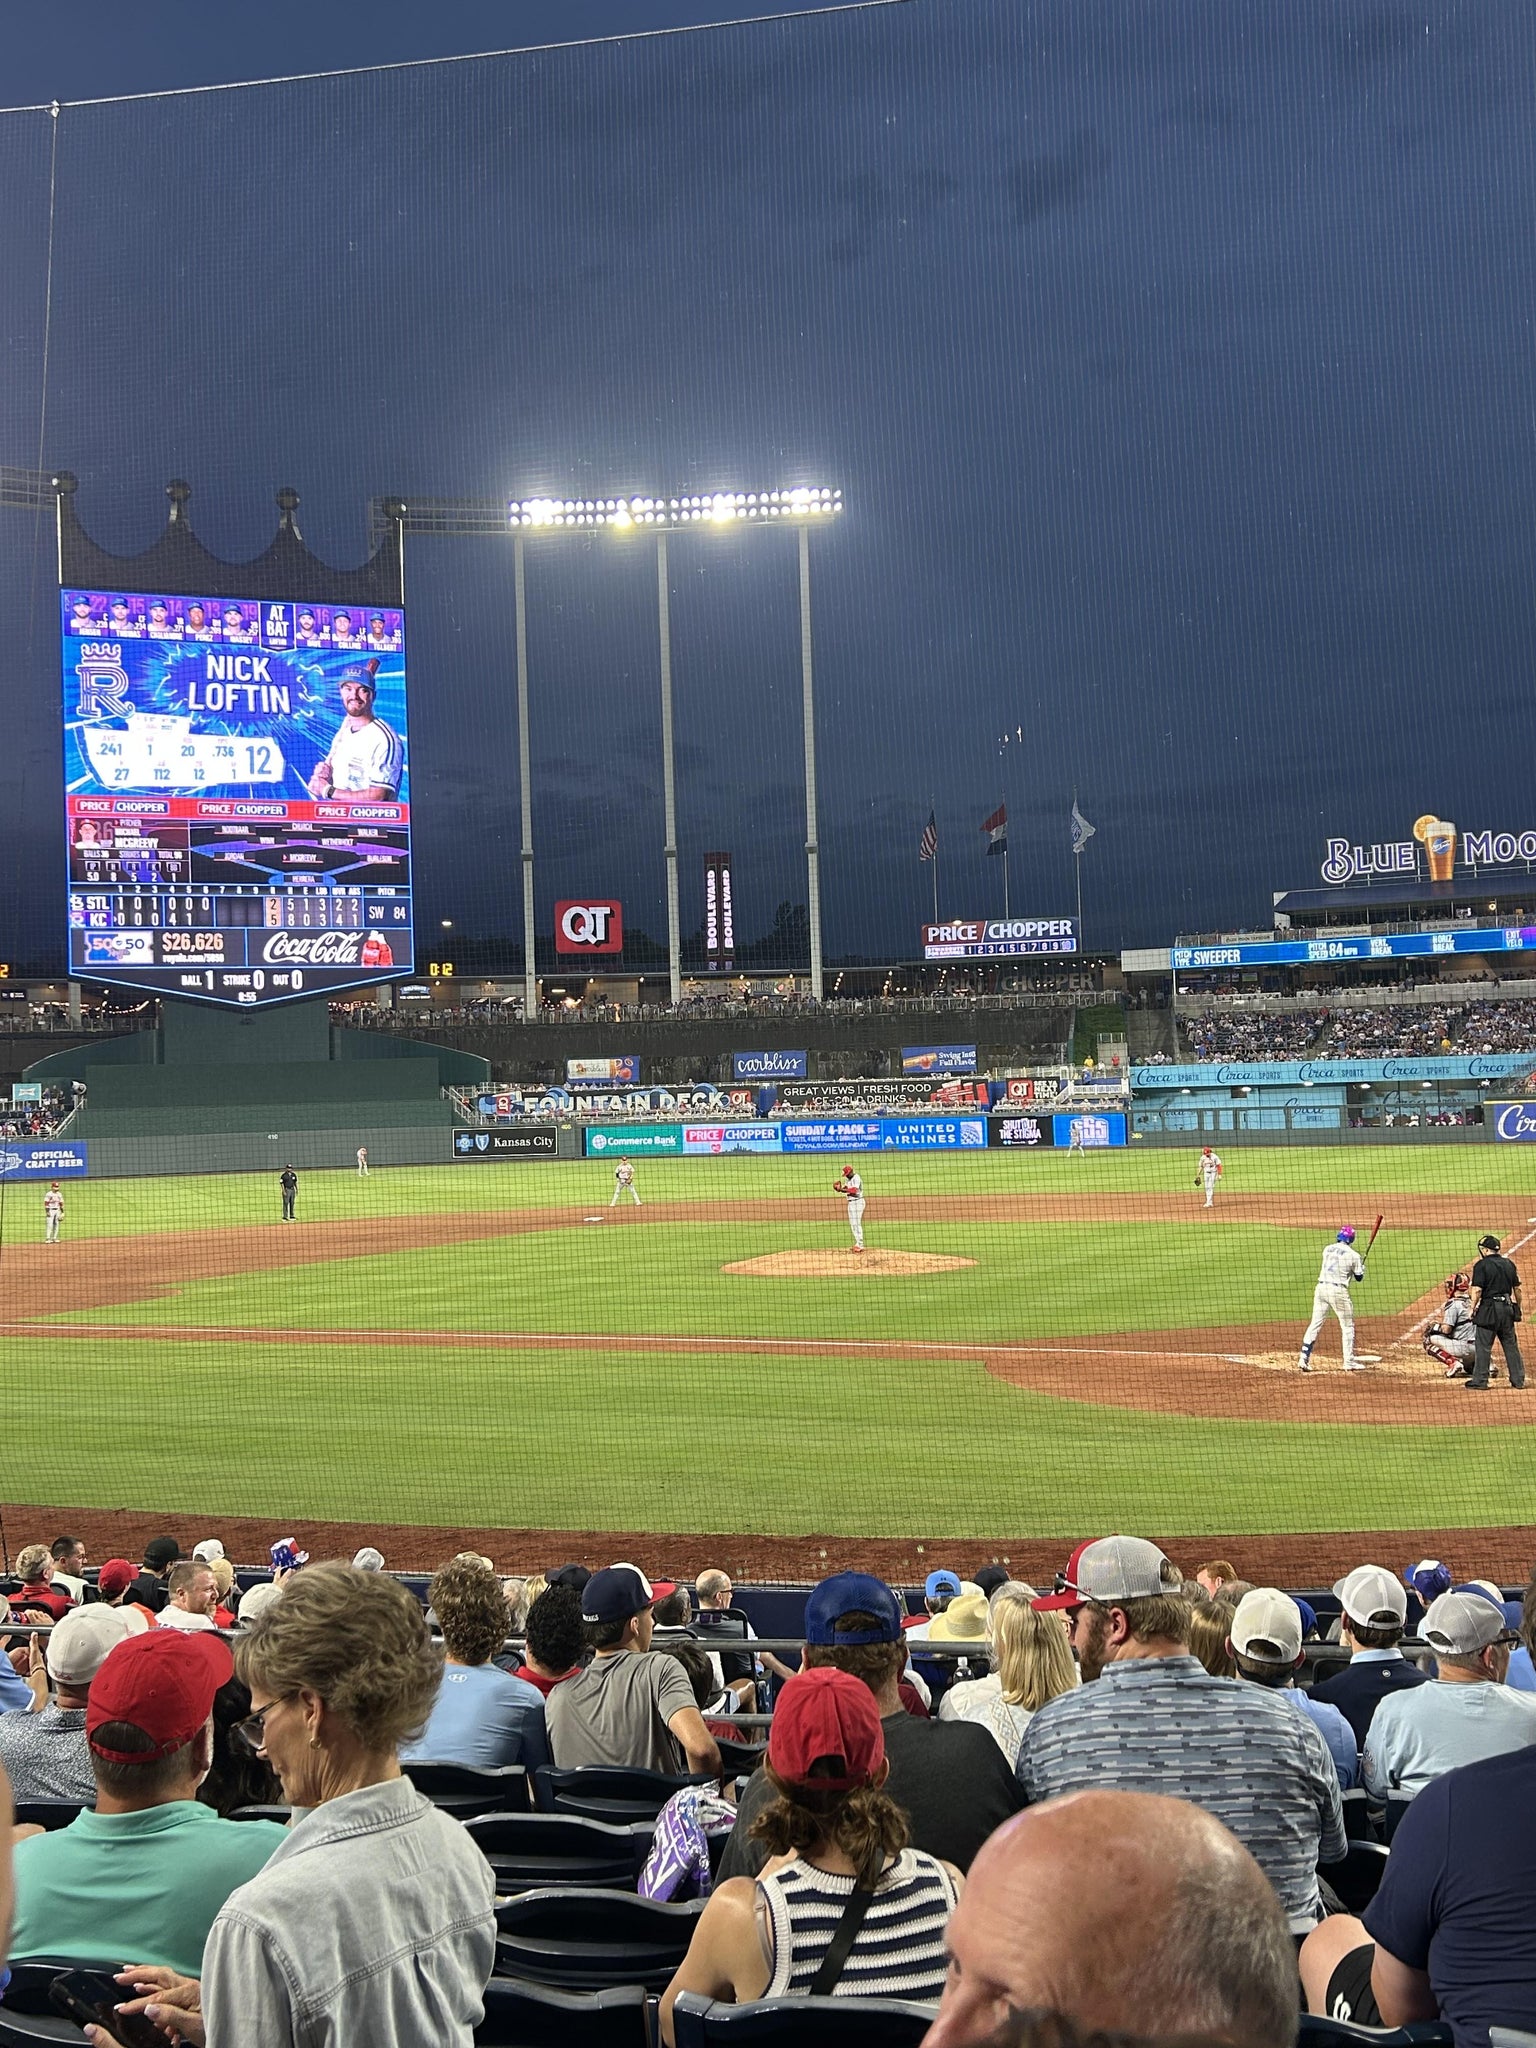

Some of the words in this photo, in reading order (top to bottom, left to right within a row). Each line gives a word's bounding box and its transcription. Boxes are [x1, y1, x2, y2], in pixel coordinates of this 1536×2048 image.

[130, 599, 144, 614] 15
[169, 601, 182, 616] 14
[244, 605, 256, 620] 19
[270, 605, 285, 620] AT
[266, 621, 289, 636] BAT
[207, 654, 273, 682] NICK
[188, 682, 291, 714] LOFTIN
[96, 744, 122, 756] .241
[181, 746, 195, 757] 20
[212, 746, 234, 757] .736
[245, 747, 272, 774] 12
[114, 769, 129, 781] 27
[154, 769, 170, 780] 112
[194, 769, 205, 780] 12
[80, 801, 110, 811] PRICE
[117, 802, 164, 812] CHOPPER
[202, 804, 230, 814] PRICE
[236, 805, 283, 815] CHOPPER
[319, 807, 346, 816] PRICE
[352, 808, 397, 818] CHOPPER
[1321, 838, 1416, 884] BLUE
[87, 873, 99, 881] 5.0
[131, 873, 137, 881] 5
[152, 873, 157, 881] 2
[135, 885, 141, 893] 2
[152, 885, 158, 893] 3
[186, 886, 192, 894] 5
[86, 896, 110, 910] STL
[118, 897, 124, 910] 1
[134, 897, 142, 910] 0
[152, 897, 157, 910] 1
[169, 897, 176, 910] 0
[186, 897, 193, 911] 0
[202, 897, 209, 911] 0
[271, 899, 276, 910] 2
[287, 899, 294, 911] 5
[319, 899, 326, 911] 3
[336, 899, 342, 911] 2
[352, 899, 358, 911] 2
[707, 870, 717, 949] BOULEVARD
[723, 870, 734, 948] BOULEVARD
[369, 906, 384, 919] SW
[393, 906, 405, 919] 84
[90, 913, 107, 927] KC
[118, 913, 125, 925] 0
[135, 913, 142, 926] 0
[151, 913, 159, 926] 0
[169, 913, 176, 926] 4
[271, 914, 277, 925] 5
[288, 915, 295, 926] 8
[304, 915, 310, 926] 0
[320, 915, 326, 926] 3
[336, 915, 343, 926] 4
[562, 906, 612, 945] QT
[927, 925, 978, 942] PRICE
[988, 920, 1072, 939] CHOPPER
[126, 939, 145, 949] 50
[162, 932, 224, 951] $26,626
[263, 931, 364, 963] Coca-Cola
[988, 945, 994, 953] 3
[1010, 944, 1015, 952] 5
[1020, 944, 1026, 952] 6
[1053, 942, 1058, 950] 9
[1194, 949, 1241, 965] SWEEPER
[1308, 942, 1327, 951] PITCH
[1329, 942, 1343, 957] 84
[1370, 939, 1388, 947] VERT.
[1506, 930, 1520, 939] EXIT
[1175, 958, 1190, 966] TYPE
[1309, 950, 1328, 959] SPEED
[1371, 946, 1393, 956] BREAK
[1433, 943, 1455, 952] BREAK
[1506, 939, 1523, 947] VELO
[430, 963, 453, 976] 0:12
[181, 975, 202, 986] BALL
[205, 970, 213, 990] 1
[223, 975, 251, 986] STRIKE
[253, 969, 264, 990] 0
[273, 974, 289, 986] OUT
[292, 969, 303, 990] 0
[738, 1052, 802, 1072] carbliss
[939, 1052, 961, 1060] Swing
[1137, 1068, 1172, 1086] Circa
[1178, 1074, 1199, 1082] SPORTS
[1217, 1065, 1251, 1084] Circa
[1259, 1071, 1281, 1080] SPORTS
[1299, 1063, 1334, 1082] Circa
[1341, 1069, 1364, 1077] SPORTS
[1382, 1060, 1420, 1079] Circa
[1426, 1066, 1450, 1075] SPORTS
[1468, 1057, 1506, 1076] Circa
[783, 1087, 819, 1096] GREAT
[822, 1085, 855, 1095] VIEWS
[863, 1084, 899, 1094] FRESH
[901, 1083, 931, 1093] FOOD
[1010, 1083, 1029, 1097] QT
[1034, 1085, 1058, 1093] NEXT
[524, 1095, 651, 1113] FOUNTAIN
[659, 1091, 724, 1109] DECK
[731, 1093, 748, 1105] QT
[867, 1094, 907, 1104] DRINKS
[786, 1125, 826, 1136] SUNDAY
[828, 1124, 865, 1135] 4-PACK
[898, 1124, 956, 1133] UNITED
[1003, 1118, 1037, 1129] SHUTOUT
[607, 1137, 652, 1146] Commerce
[654, 1136, 676, 1145] Bank
[689, 1130, 719, 1141] PRICE
[725, 1128, 776, 1139] CHOPPER
[885, 1134, 956, 1145] AIRLINES
[999, 1129, 1017, 1139] THE
[1014, 1129, 1041, 1139] STIGMA
[494, 1138, 531, 1147] Kansas
[534, 1136, 554, 1148] City
[31, 1151, 75, 1159] OFFICIAL
[25, 1160, 57, 1168] CRAFT
[58, 1159, 83, 1167] BEER
